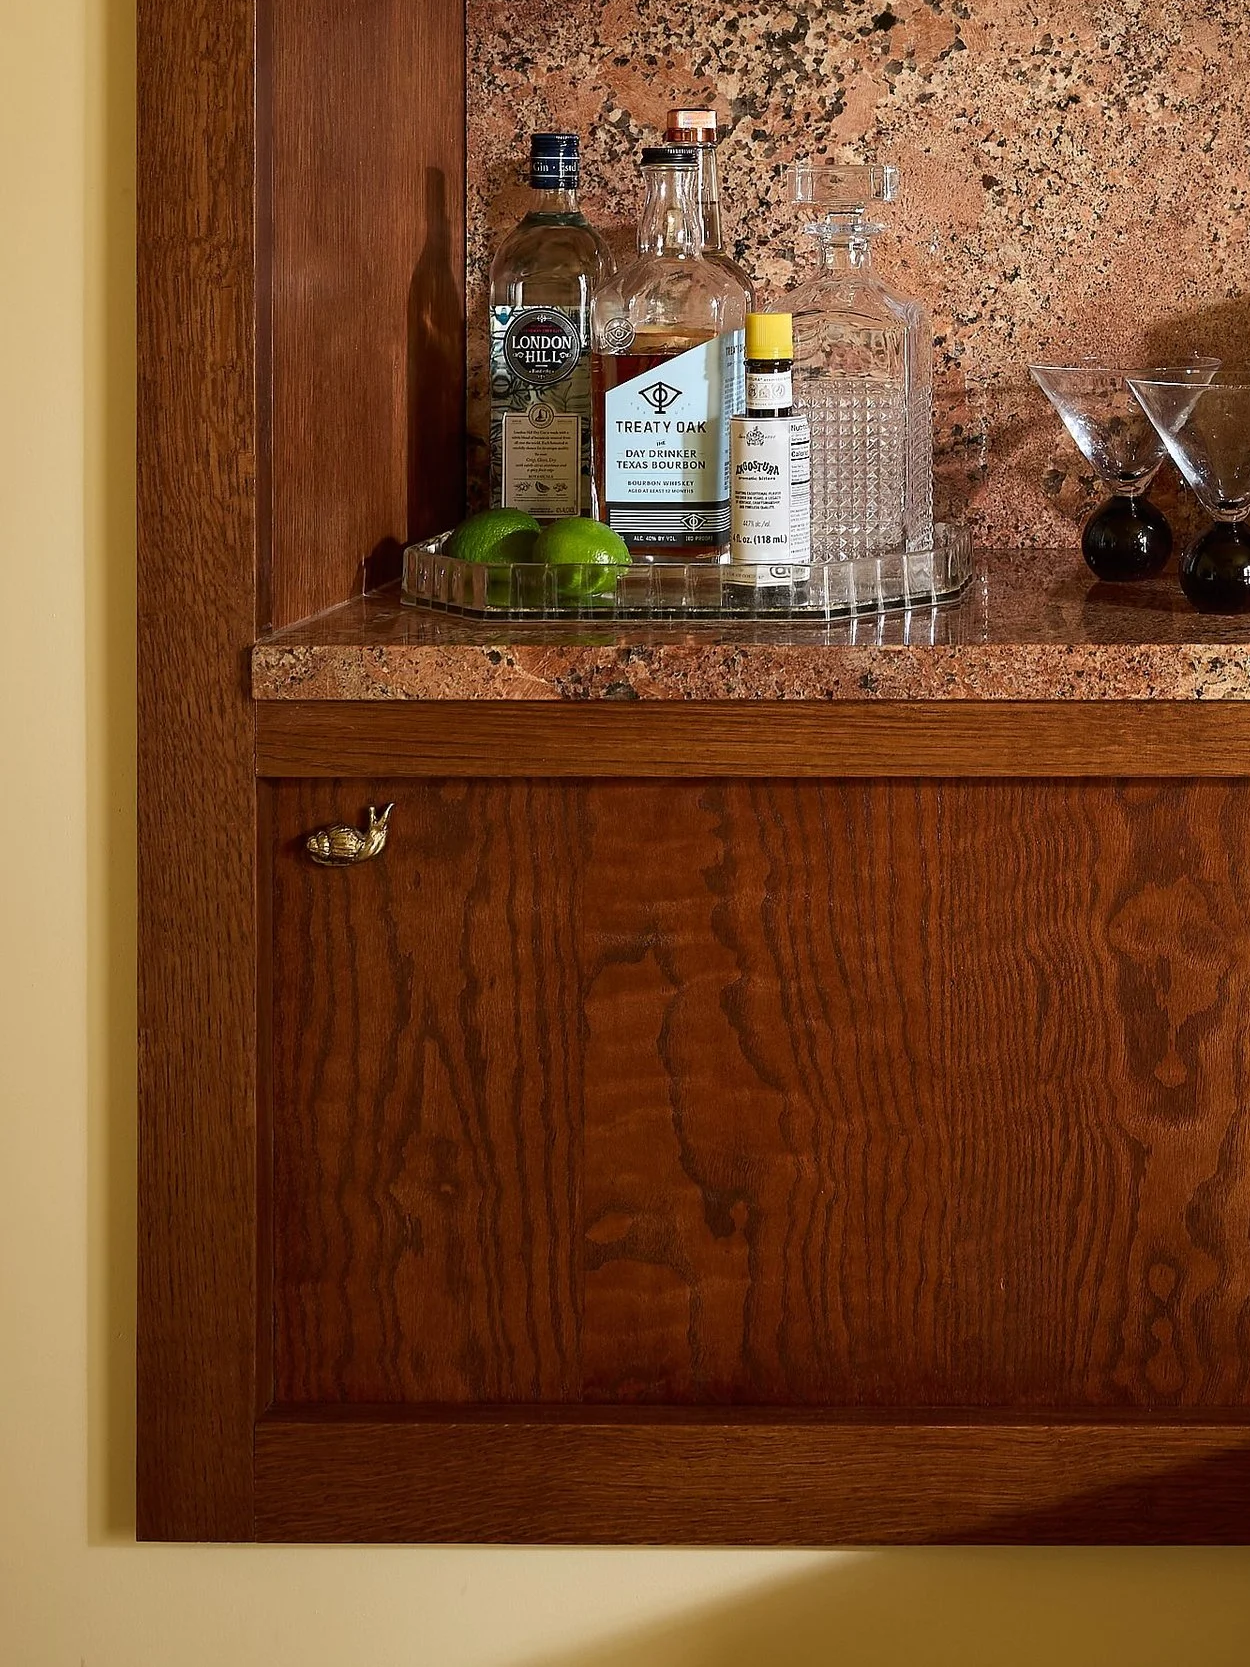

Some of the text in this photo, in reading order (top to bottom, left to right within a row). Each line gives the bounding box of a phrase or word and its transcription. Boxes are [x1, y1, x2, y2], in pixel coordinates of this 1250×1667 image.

[532, 161, 549, 172] Gin
[512, 335, 573, 349] LONDON
[525, 350, 563, 364] HILL
[615, 421, 707, 433] TREATY OAK
[625, 449, 697, 458] DAY DRINKER
[616, 460, 706, 470] TEXAS BOURBON
[735, 460, 780, 476] ANGOSTURA
[742, 534, 788, 545] oz. (118 mL)
